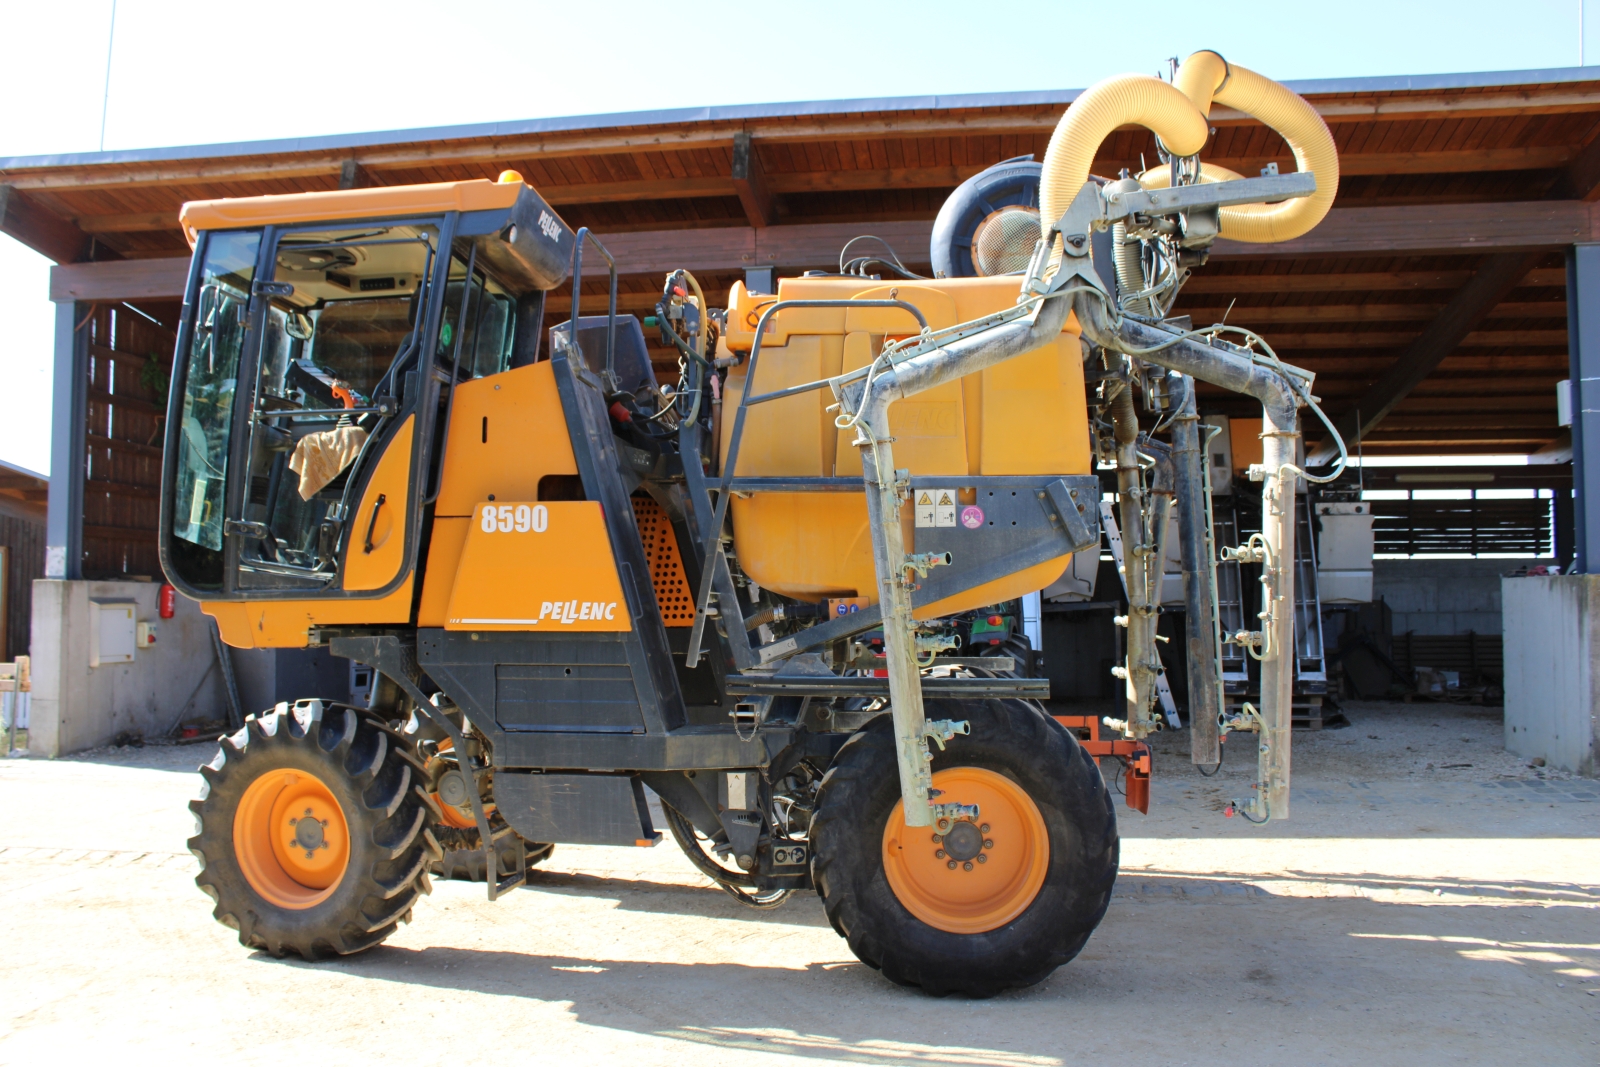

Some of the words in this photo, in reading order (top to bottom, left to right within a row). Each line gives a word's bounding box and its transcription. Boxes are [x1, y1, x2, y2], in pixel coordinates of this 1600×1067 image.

[538, 209, 562, 243] PELLENC
[481, 505, 548, 533] 8590
[539, 600, 617, 624] PELLENC
